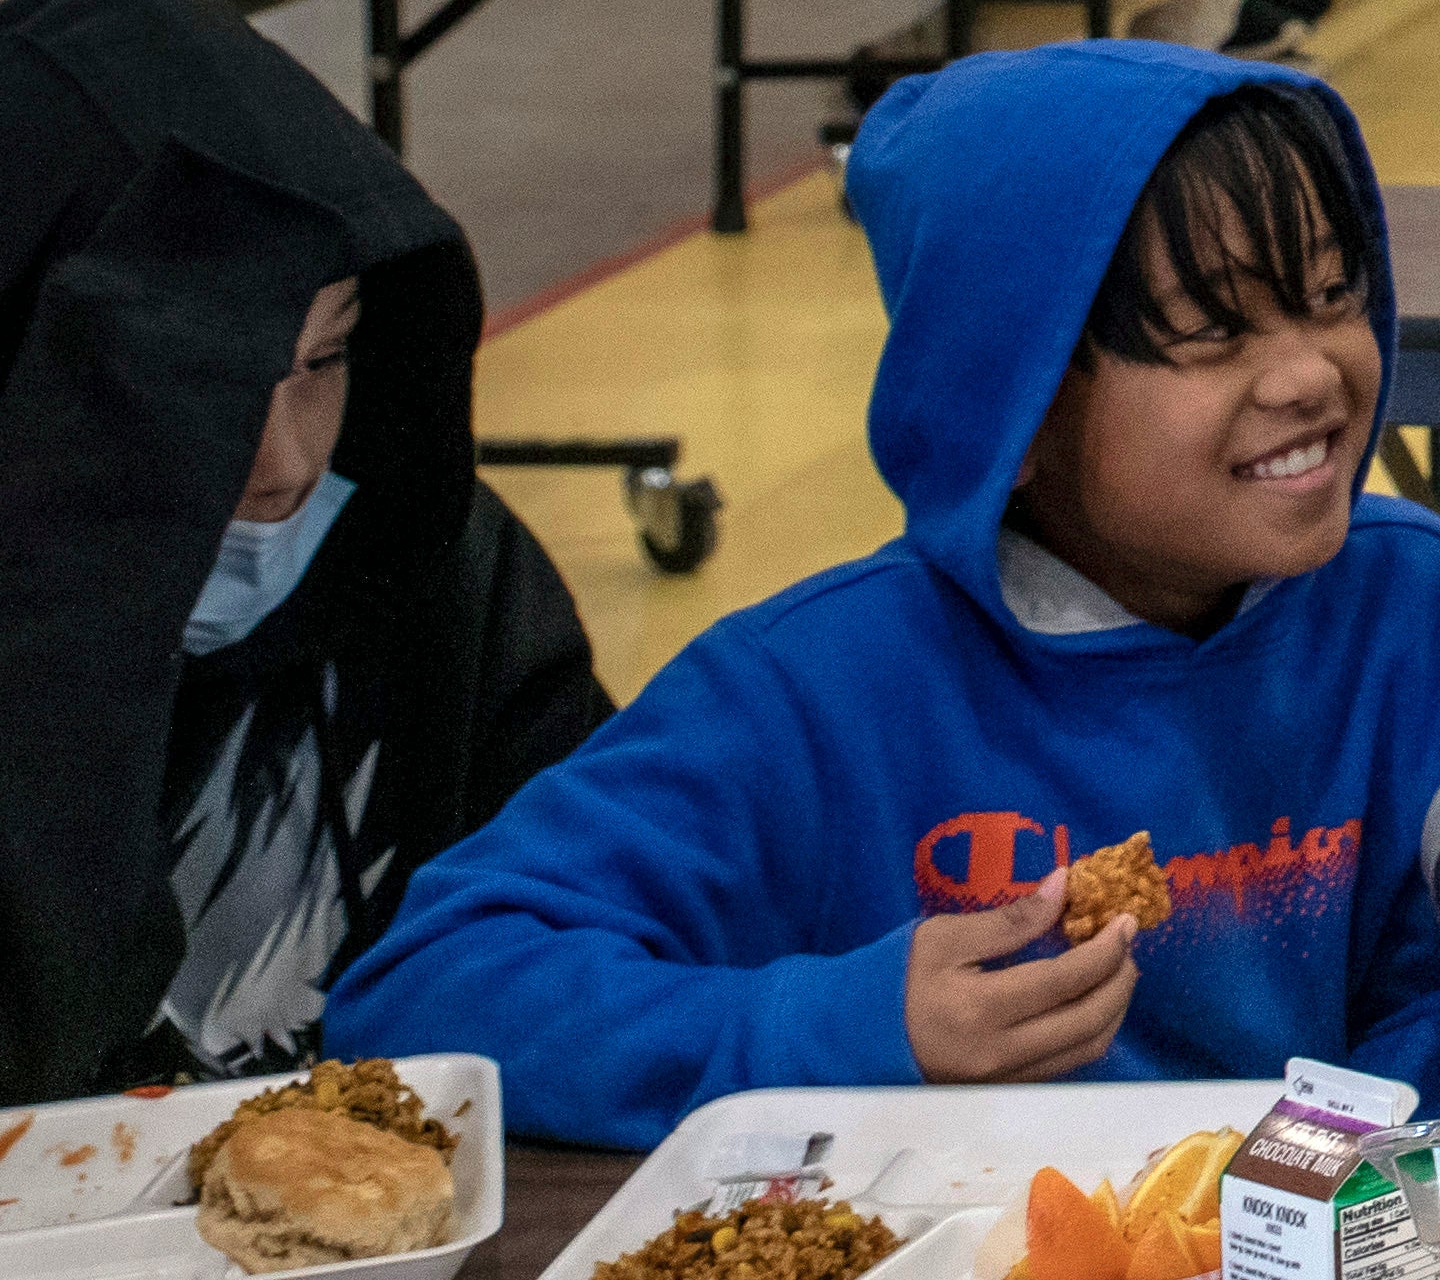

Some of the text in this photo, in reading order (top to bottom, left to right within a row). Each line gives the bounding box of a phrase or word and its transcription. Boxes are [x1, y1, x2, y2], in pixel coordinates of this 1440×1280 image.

[1249, 1138, 1346, 1178] CHOCOLATE MILK
[1343, 1195, 1402, 1223] Nutrition
